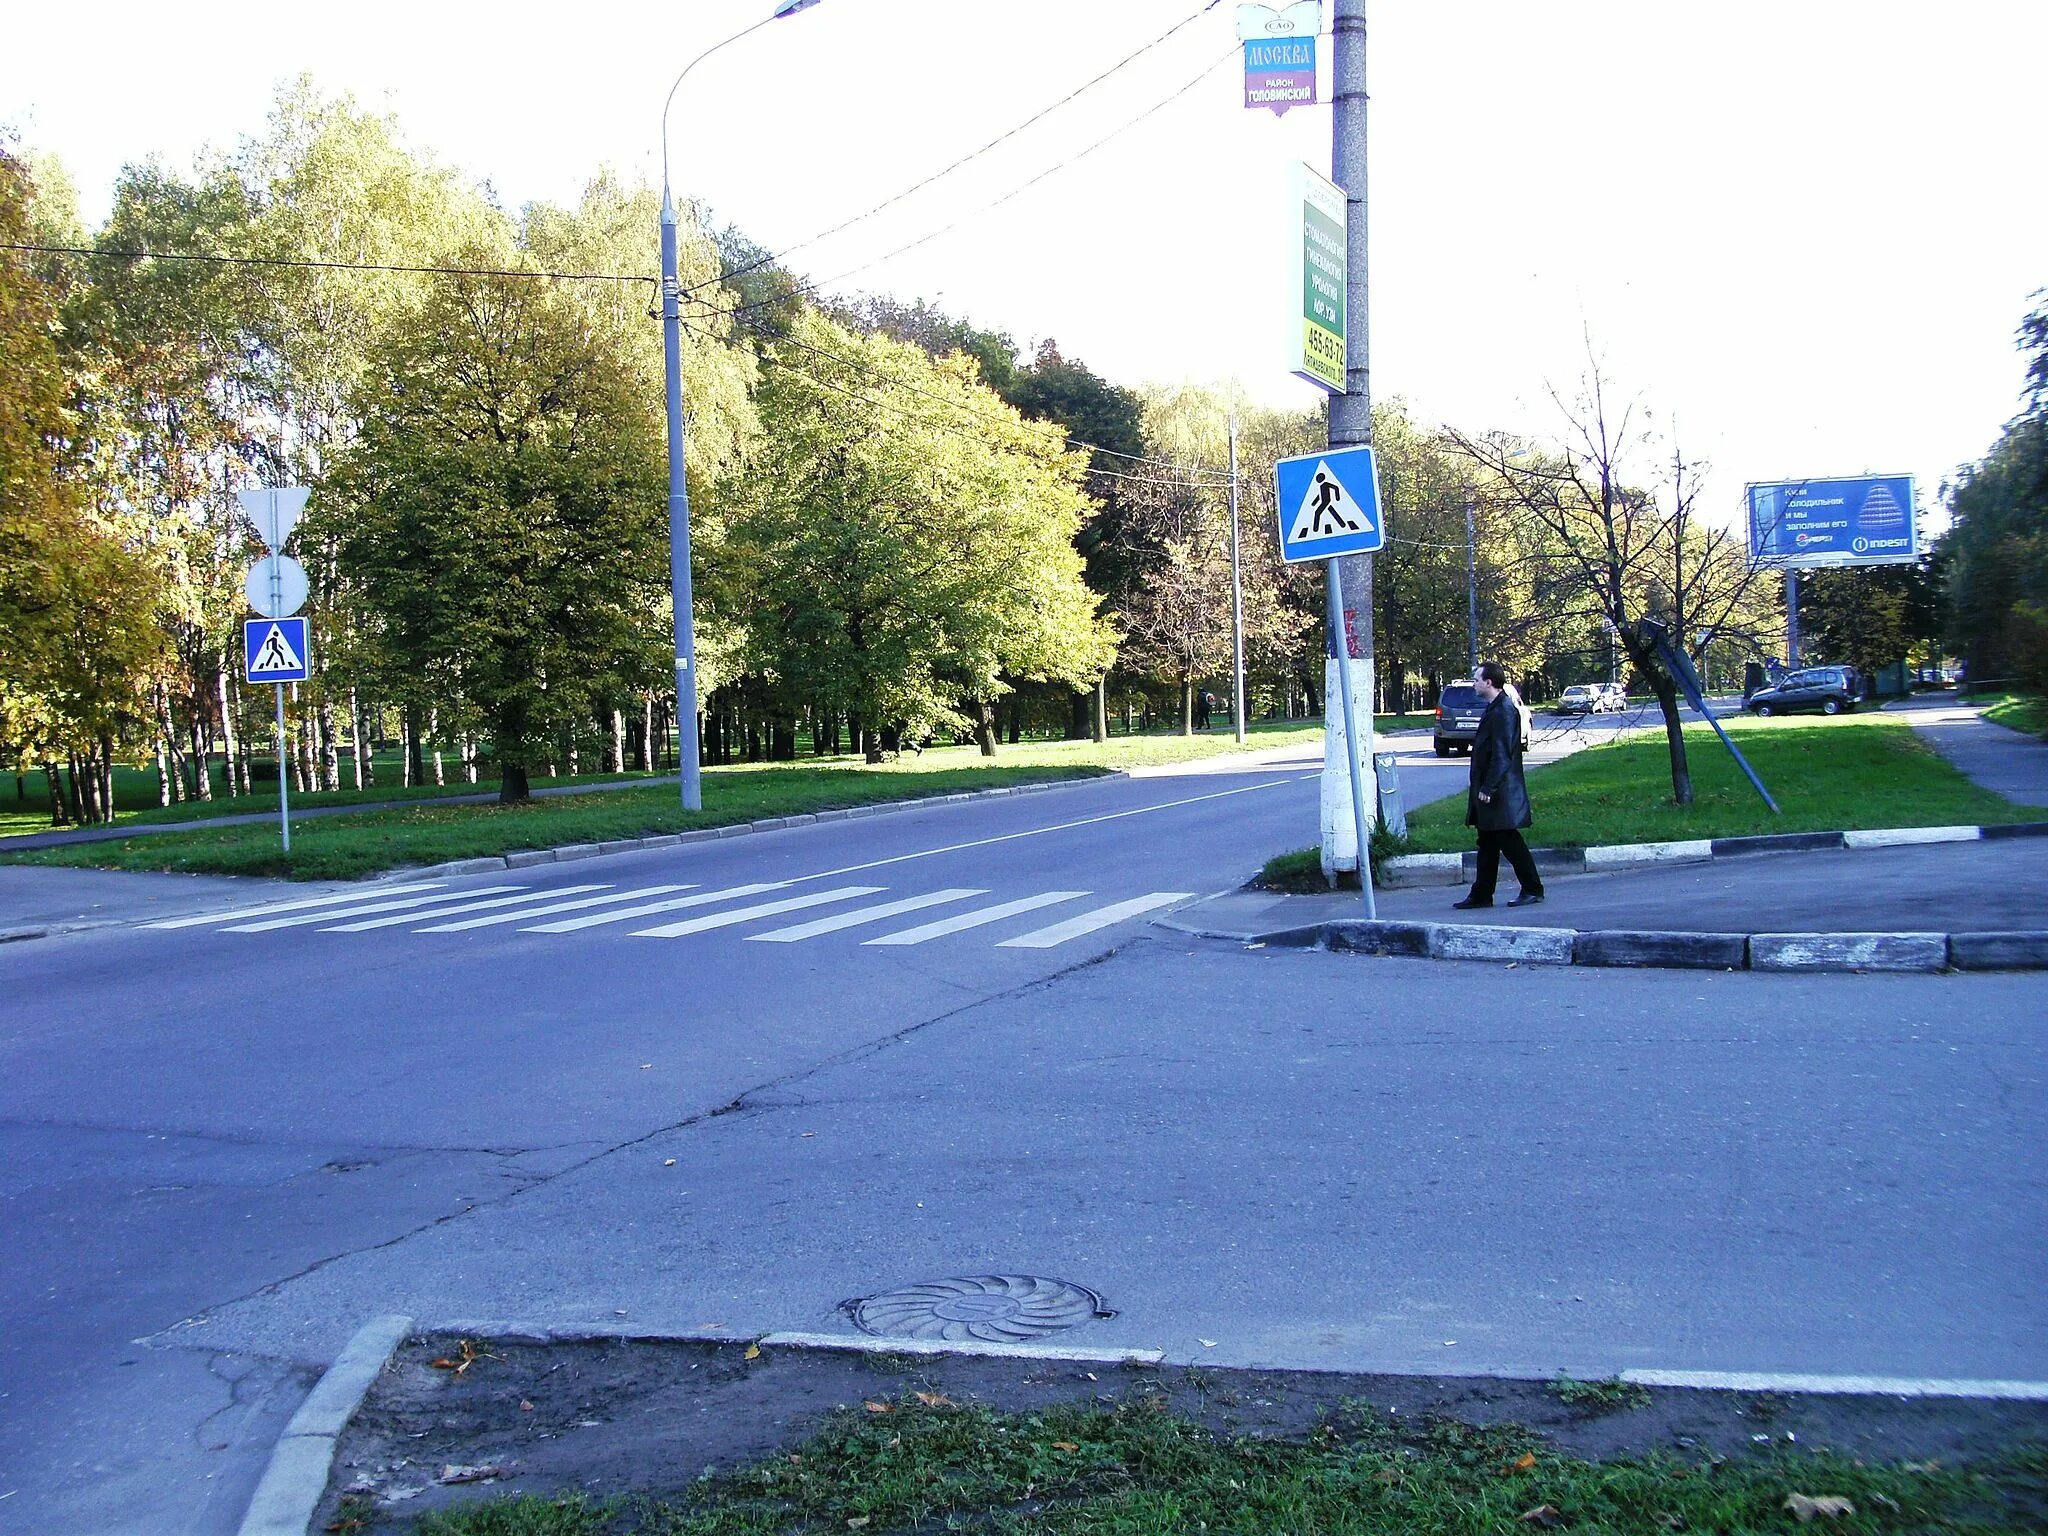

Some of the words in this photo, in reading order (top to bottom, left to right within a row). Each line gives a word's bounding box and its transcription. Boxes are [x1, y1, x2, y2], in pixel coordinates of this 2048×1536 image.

[1248, 44, 1310, 65] МОСКВА
[1265, 78, 1294, 87] РАЙОН
[1248, 86, 1311, 102] ГОЛОВИНСКИЙ
[1785, 522, 1830, 531] заполним
[1831, 520, 1848, 528] его
